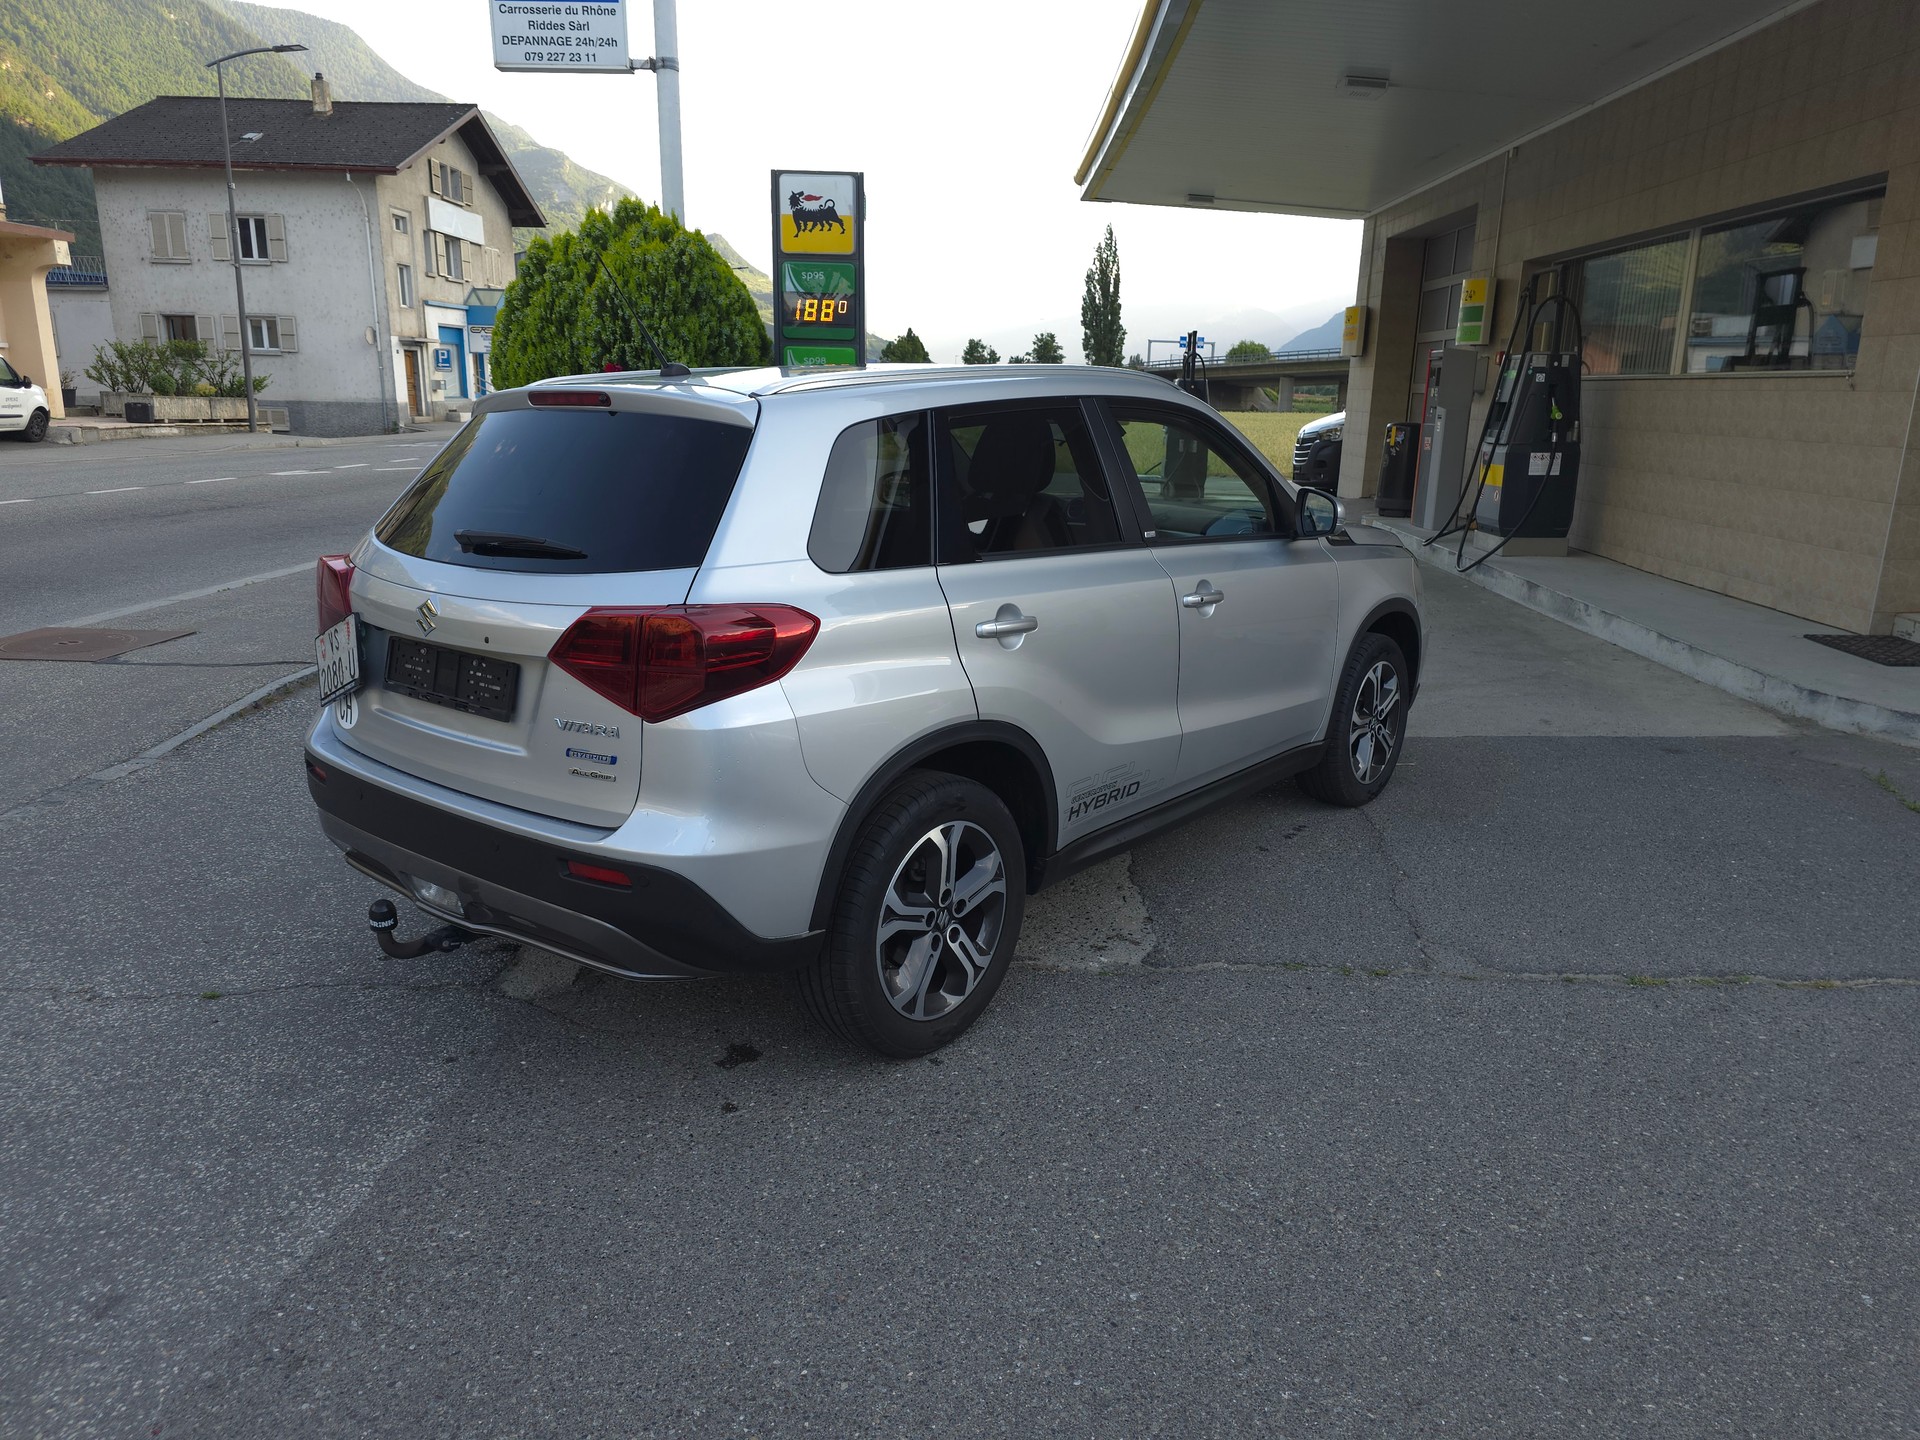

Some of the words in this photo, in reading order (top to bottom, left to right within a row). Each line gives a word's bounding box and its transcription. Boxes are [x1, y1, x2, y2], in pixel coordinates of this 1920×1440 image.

[499, 4, 562, 15] Carrosserie
[565, 5, 579, 16] du
[582, 5, 617, 16] Rhône
[528, 20, 566, 31] Riddes
[569, 20, 590, 32] Sàrl
[502, 35, 573, 47] DEPANNAGE
[575, 37, 618, 48] 24h/24h
[524, 52, 544, 62] 079
[547, 52, 566, 62] 227
[569, 52, 582, 62] 23
[585, 53, 597, 62] 11
[438, 350, 448, 363] P
[328, 628, 340, 655] VS
[554, 717, 620, 739] VITARA
[571, 750, 609, 763] HYBRID
[1067, 781, 1140, 822] HYBRID
